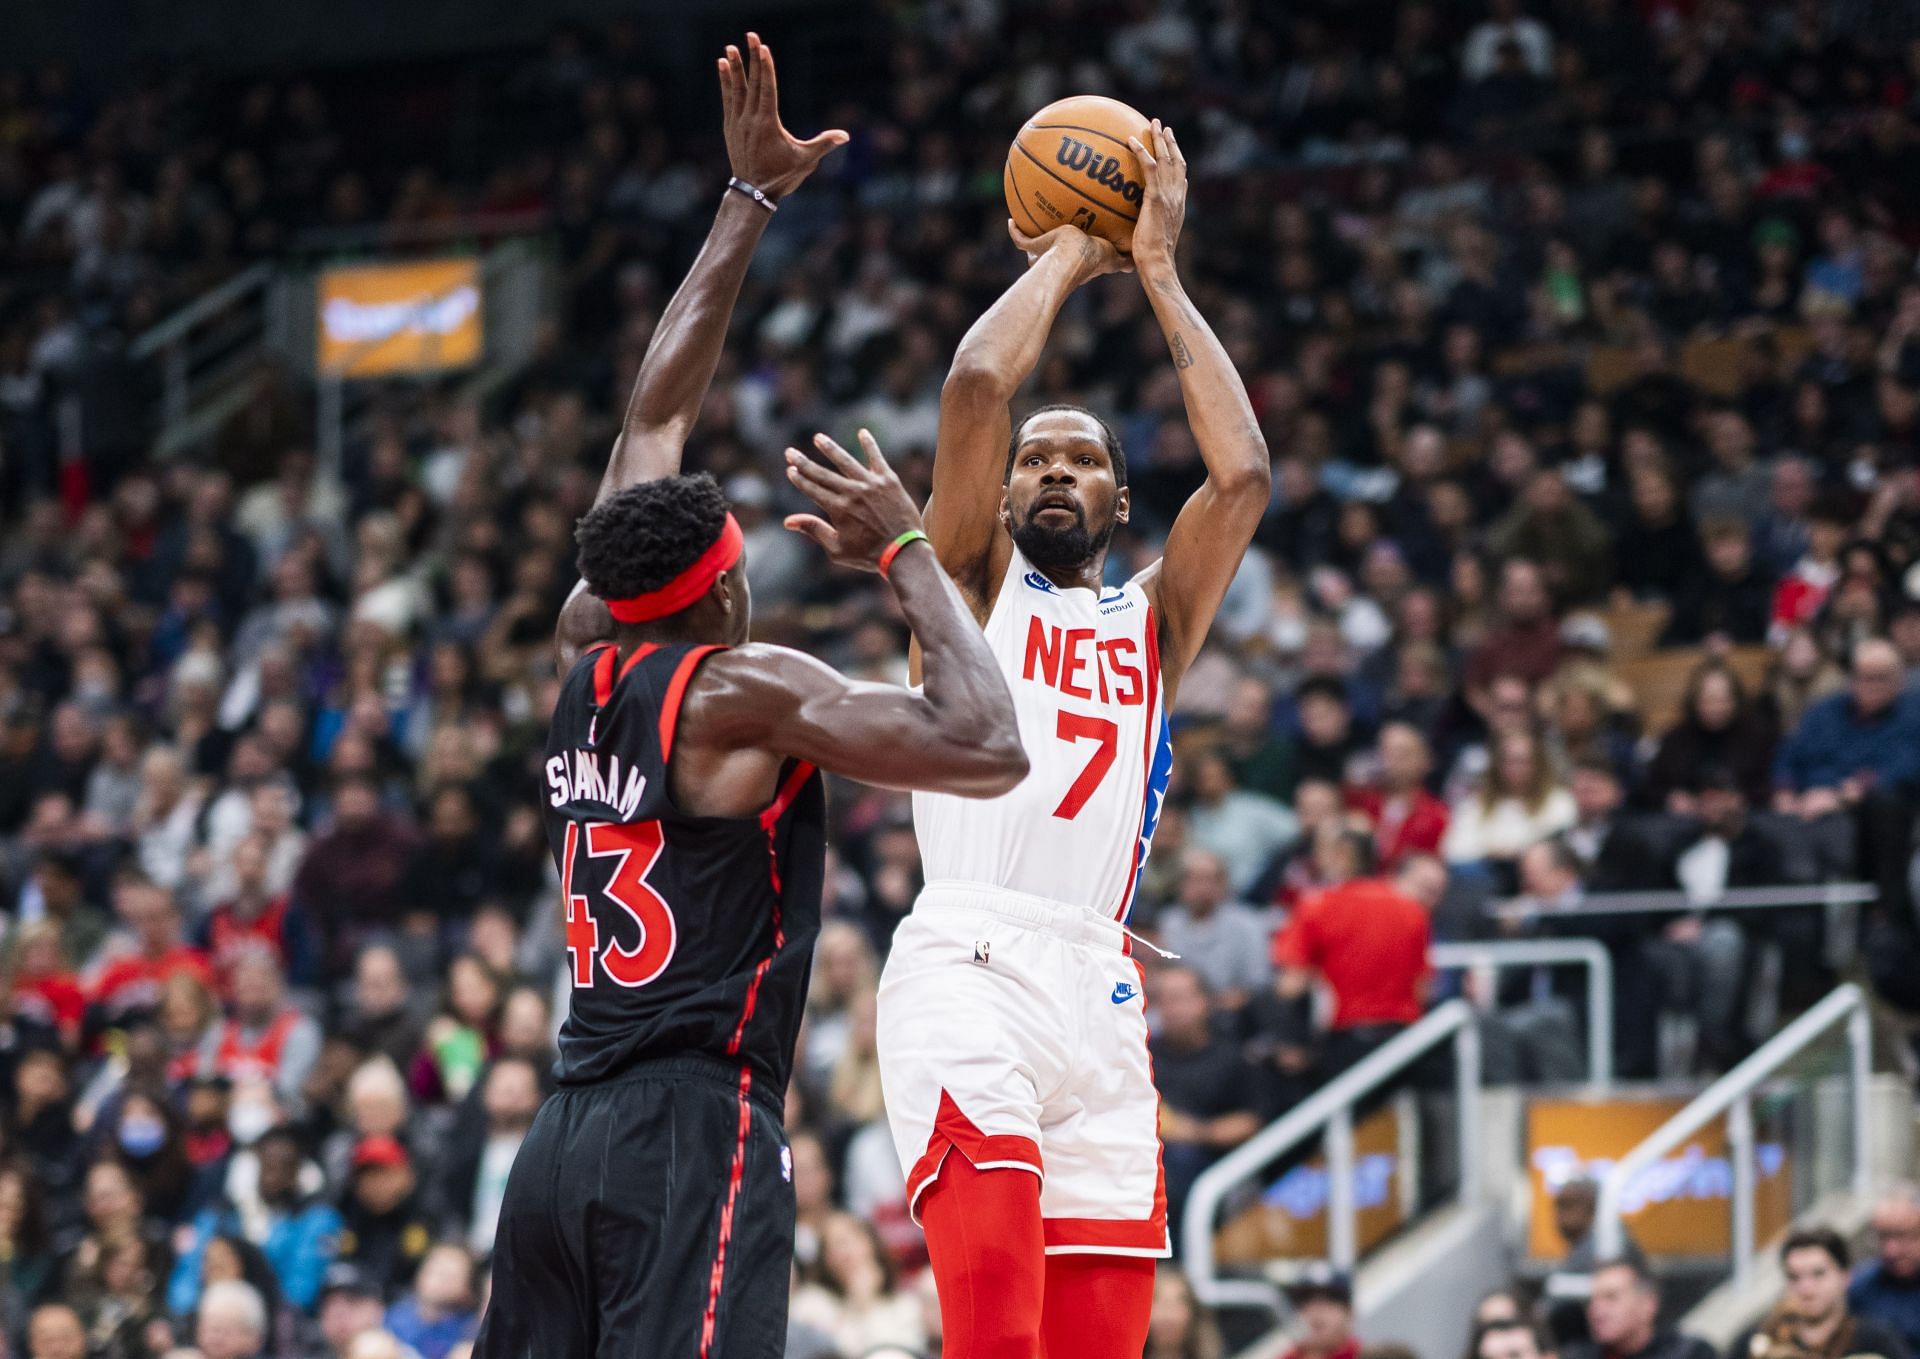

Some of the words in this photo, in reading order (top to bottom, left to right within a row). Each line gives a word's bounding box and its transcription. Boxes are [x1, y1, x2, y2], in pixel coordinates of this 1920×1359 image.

[1100, 601, 1134, 616] Webull
[545, 748, 647, 822] SIAKAM
[1051, 709, 1118, 820] 7
[562, 819, 677, 988] 43
